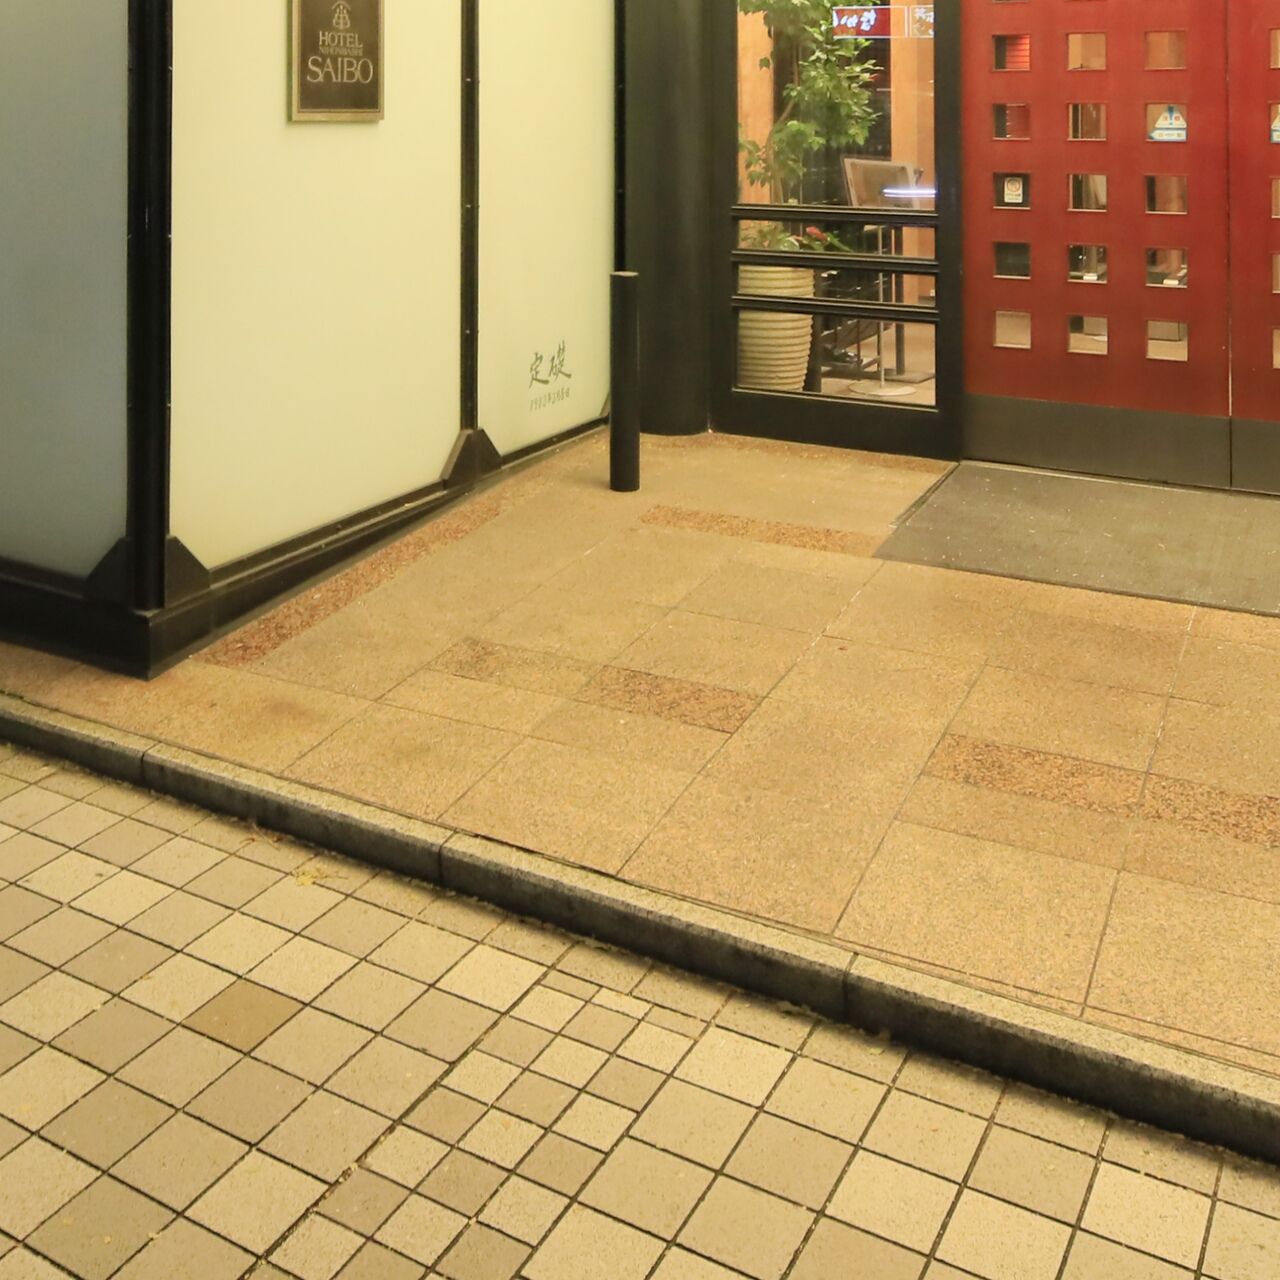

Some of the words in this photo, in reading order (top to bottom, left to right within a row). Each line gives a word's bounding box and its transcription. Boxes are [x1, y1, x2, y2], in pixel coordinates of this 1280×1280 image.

[319, 31, 363, 48] HOTEL
[307, 56, 373, 84] SAIBO
[529, 339, 572, 389] 定礎
